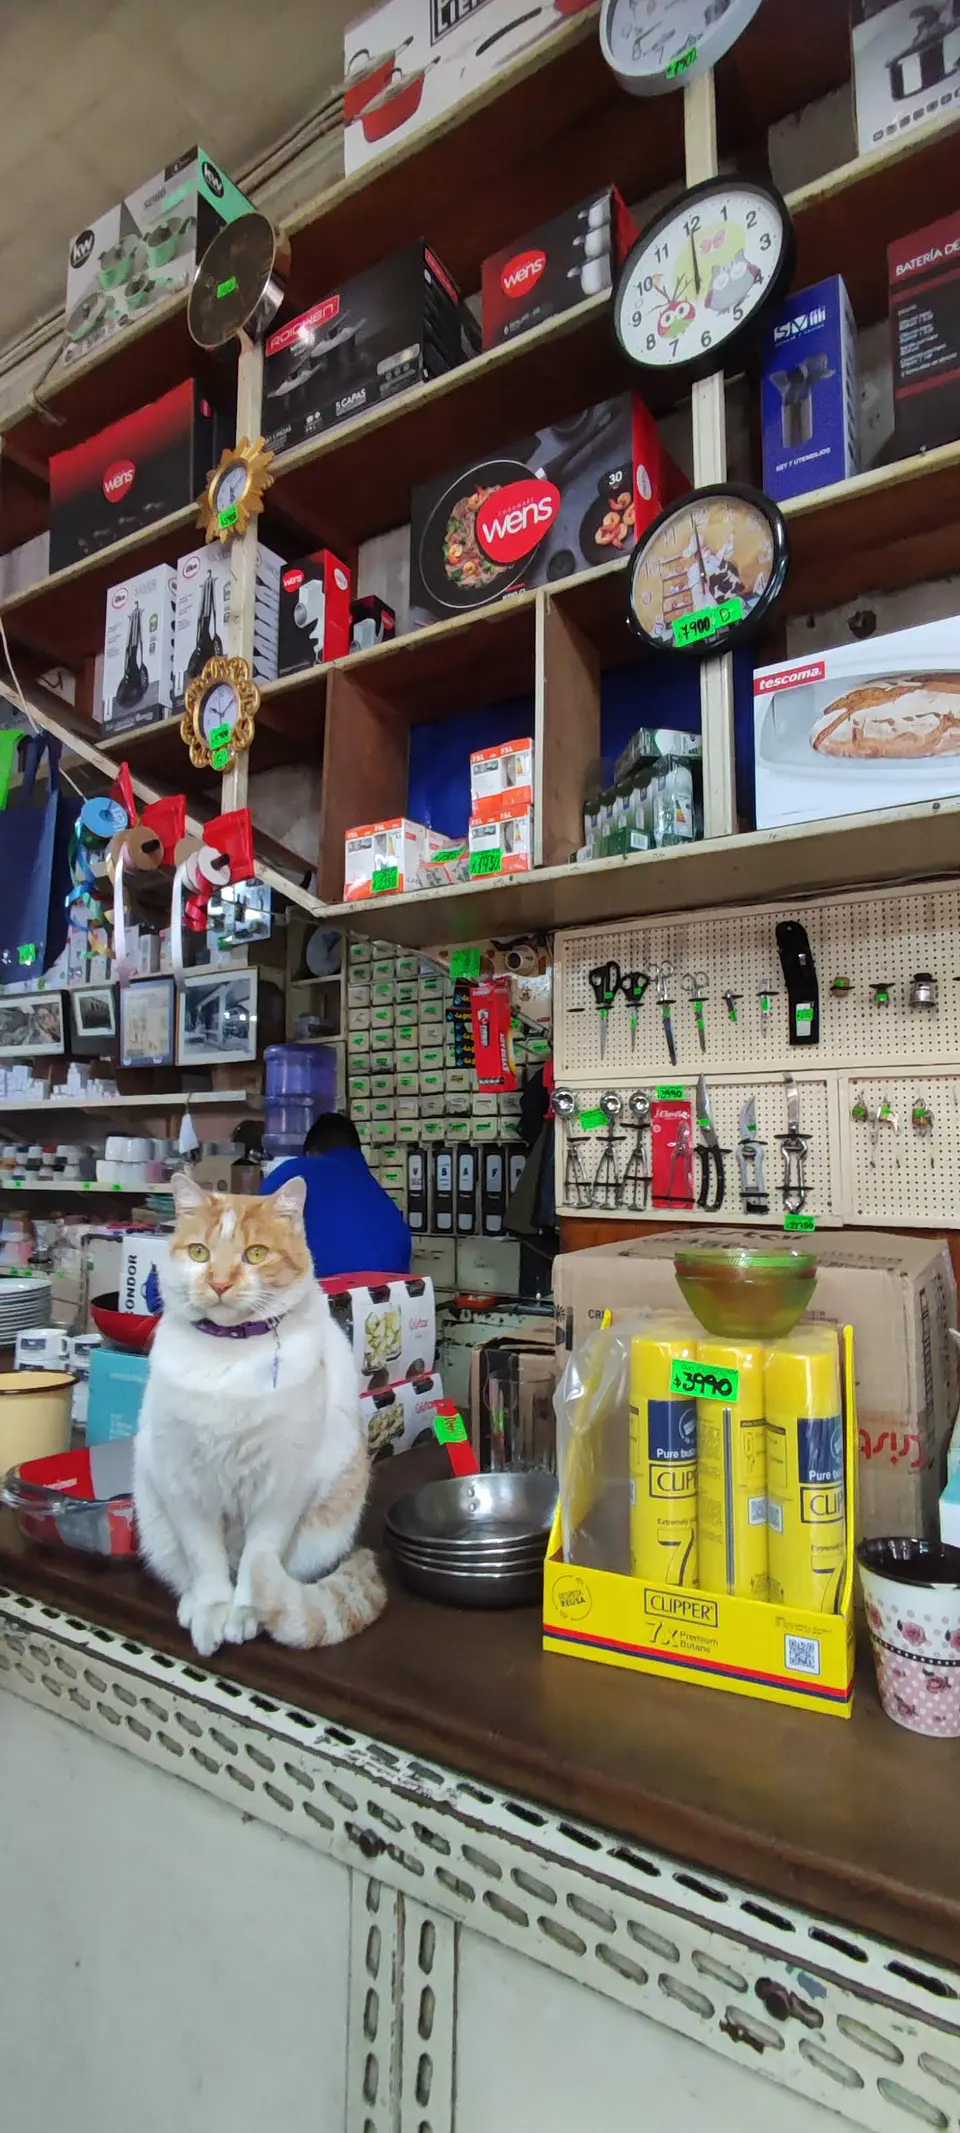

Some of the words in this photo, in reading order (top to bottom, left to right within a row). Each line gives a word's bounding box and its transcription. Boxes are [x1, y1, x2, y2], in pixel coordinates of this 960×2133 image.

[720, 205, 728, 222] 1
[746, 211, 758, 230] 2
[682, 215, 701, 237] 12
[759, 233, 772, 251] 3
[654, 243, 669, 263] 11
[896, 248, 943, 276] BATERÍA
[503, 257, 546, 290] wens
[753, 268, 764, 286] 4
[636, 276, 653, 297] 10
[631, 310, 642, 328] 9
[732, 304, 743, 321] 5
[645, 333, 657, 351] 8
[668, 338, 679, 357] 7
[700, 330, 712, 348] 6
[341, 388, 366, 407] CAPAS
[103, 466, 134, 494] wens
[608, 470, 623, 485] 30
[481, 495, 553, 543] wens
[284, 574, 303, 587] wens
[441, 1167, 448, 1177] B
[463, 1167, 469, 1176] A
[492, 1168, 498, 1178] F
[126, 1254, 138, 1315] ONDOR
[673, 1371, 733, 1397] $3990
[656, 1448, 679, 1459] Pure
[808, 1469, 831, 1481] Pure
[657, 1528, 694, 1587] 7
[650, 1595, 711, 1621] CLIPPER
[680, 1630, 719, 1647] Premium
[680, 1640, 711, 1653] Butane
